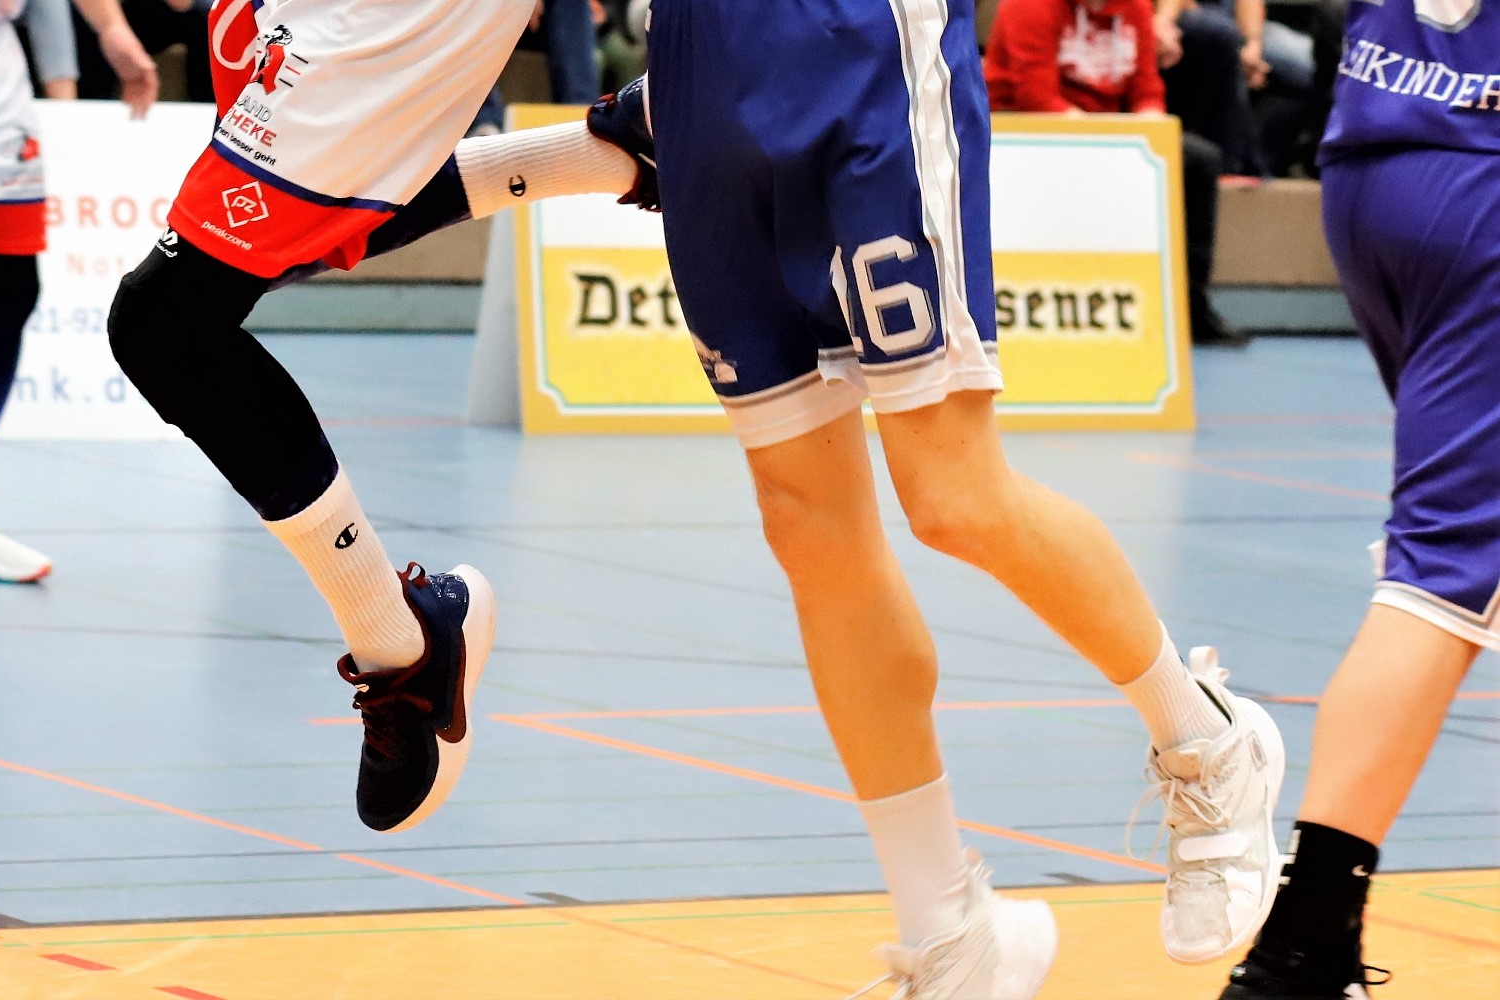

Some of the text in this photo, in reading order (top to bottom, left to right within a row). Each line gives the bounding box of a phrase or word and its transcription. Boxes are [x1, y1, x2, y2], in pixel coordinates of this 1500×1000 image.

[201, 220, 253, 250] peakzone
[574, 273, 677, 327] Det
[996, 290, 1134, 330] sener
